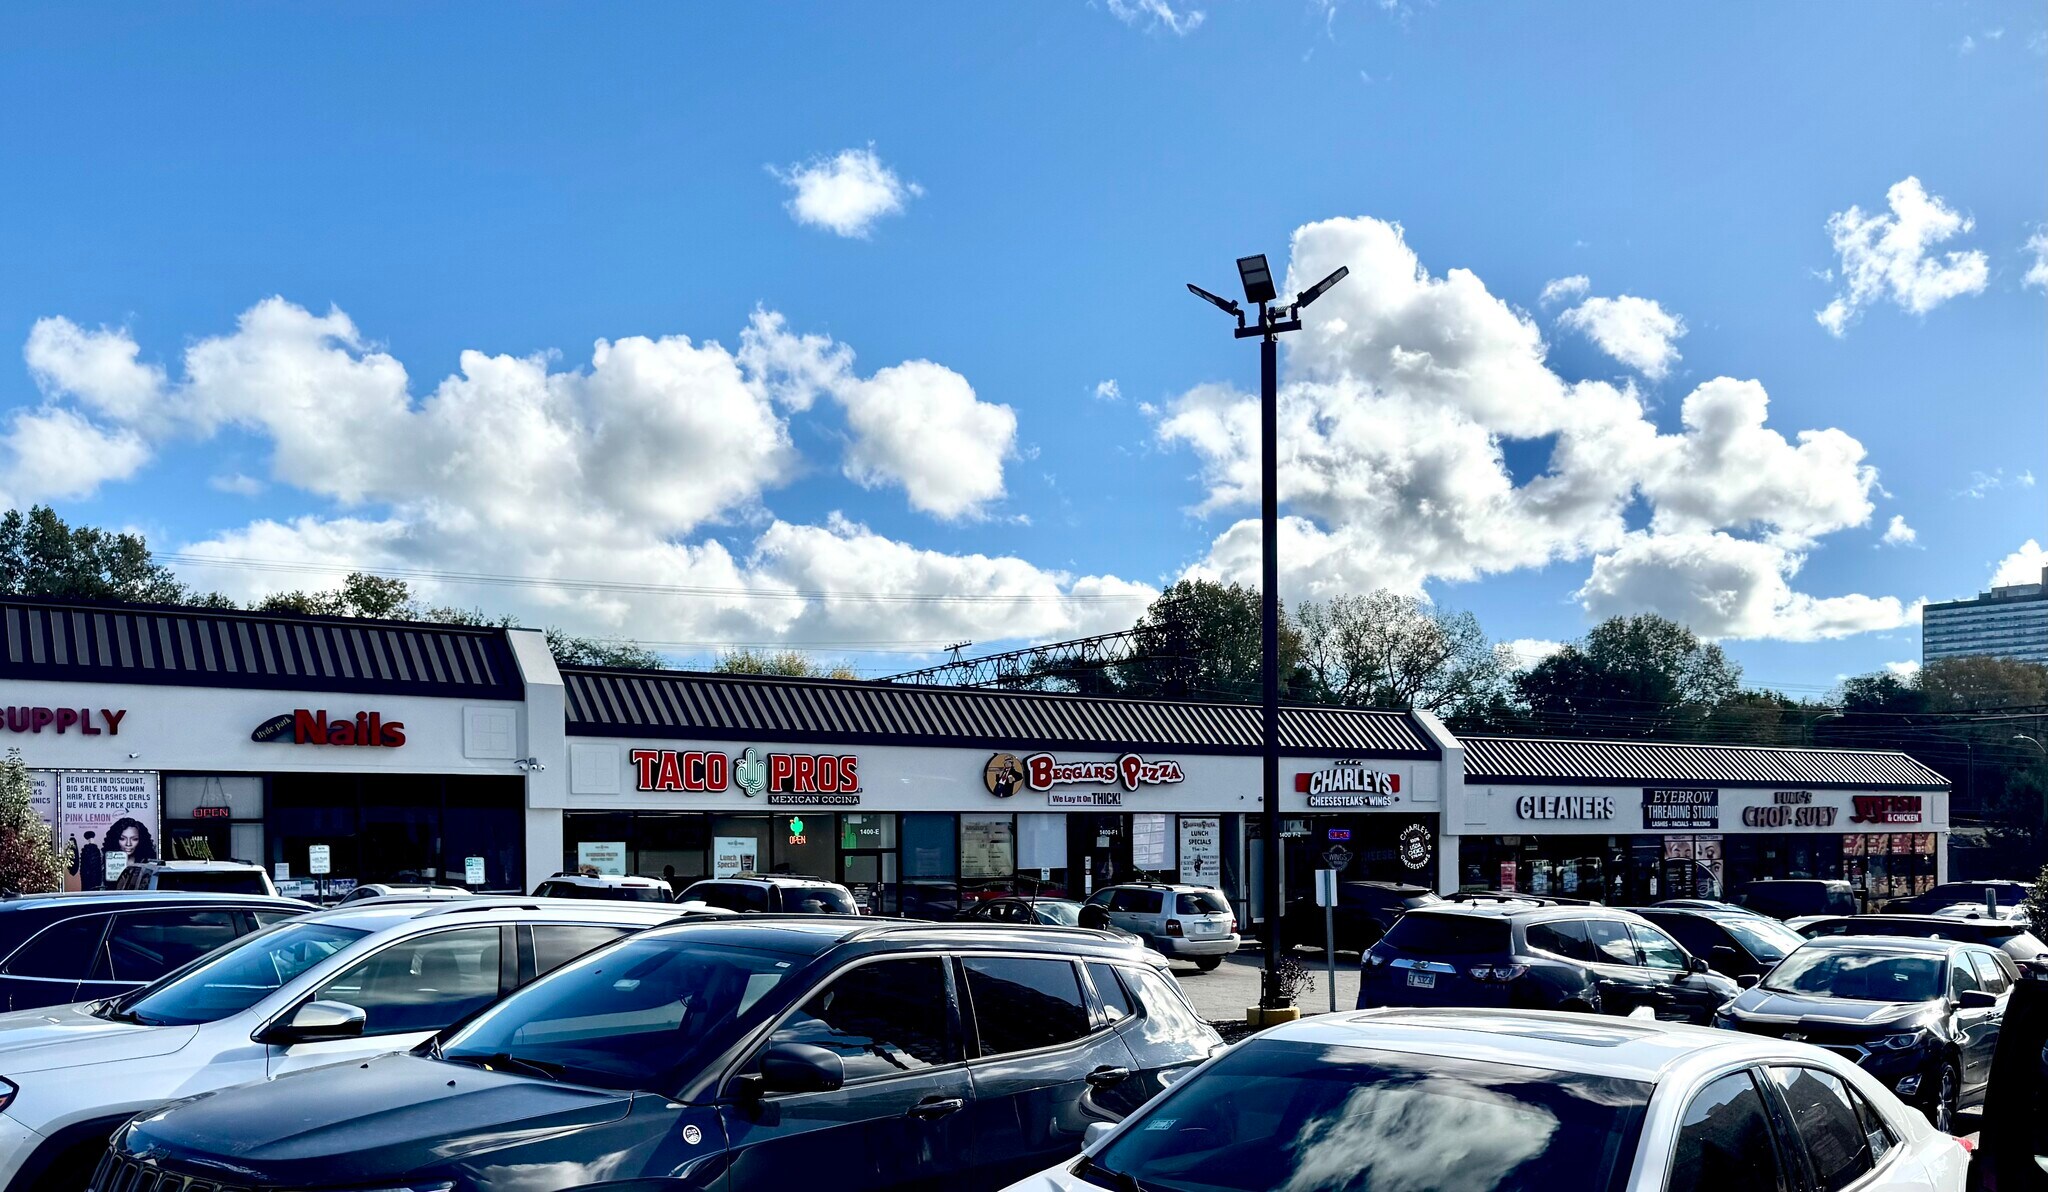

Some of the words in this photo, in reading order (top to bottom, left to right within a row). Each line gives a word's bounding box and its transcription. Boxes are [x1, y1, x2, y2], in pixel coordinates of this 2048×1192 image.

[0, 706, 127, 735] UPPLY
[256, 726, 275, 740] Hyde
[294, 709, 406, 748] Nails
[632, 749, 729, 792] TACO
[769, 753, 860, 793] PROS
[66, 776, 108, 784] BEAUTICIAN
[1309, 768, 1393, 796] CHARLEYS
[100, 785, 118, 793] 100%
[120, 785, 145, 793] HUMAN
[771, 795, 820, 804] MEXICAN
[821, 796, 859, 804] COCINA
[1064, 795, 1076, 805] Lay
[1092, 792, 1121, 805] THICK!
[1310, 796, 1364, 807] CHEESESTEAKS
[1369, 796, 1392, 807] WINGS
[1653, 790, 1714, 804] EYEBROW
[193, 808, 229, 818] OPEN
[1518, 796, 1616, 820] CLEANERS
[1648, 804, 1691, 820] THREADING
[1692, 804, 1719, 820] STUDIO
[65, 813, 84, 822] PINK
[85, 813, 111, 822] LEMON
[1795, 806, 1839, 827] SUEY
[1887, 813, 1893, 822] &
[1893, 813, 1919, 822] CHICKEN
[1399, 823, 1432, 841] CHARLEYS
[789, 835, 806, 845] OPEN
